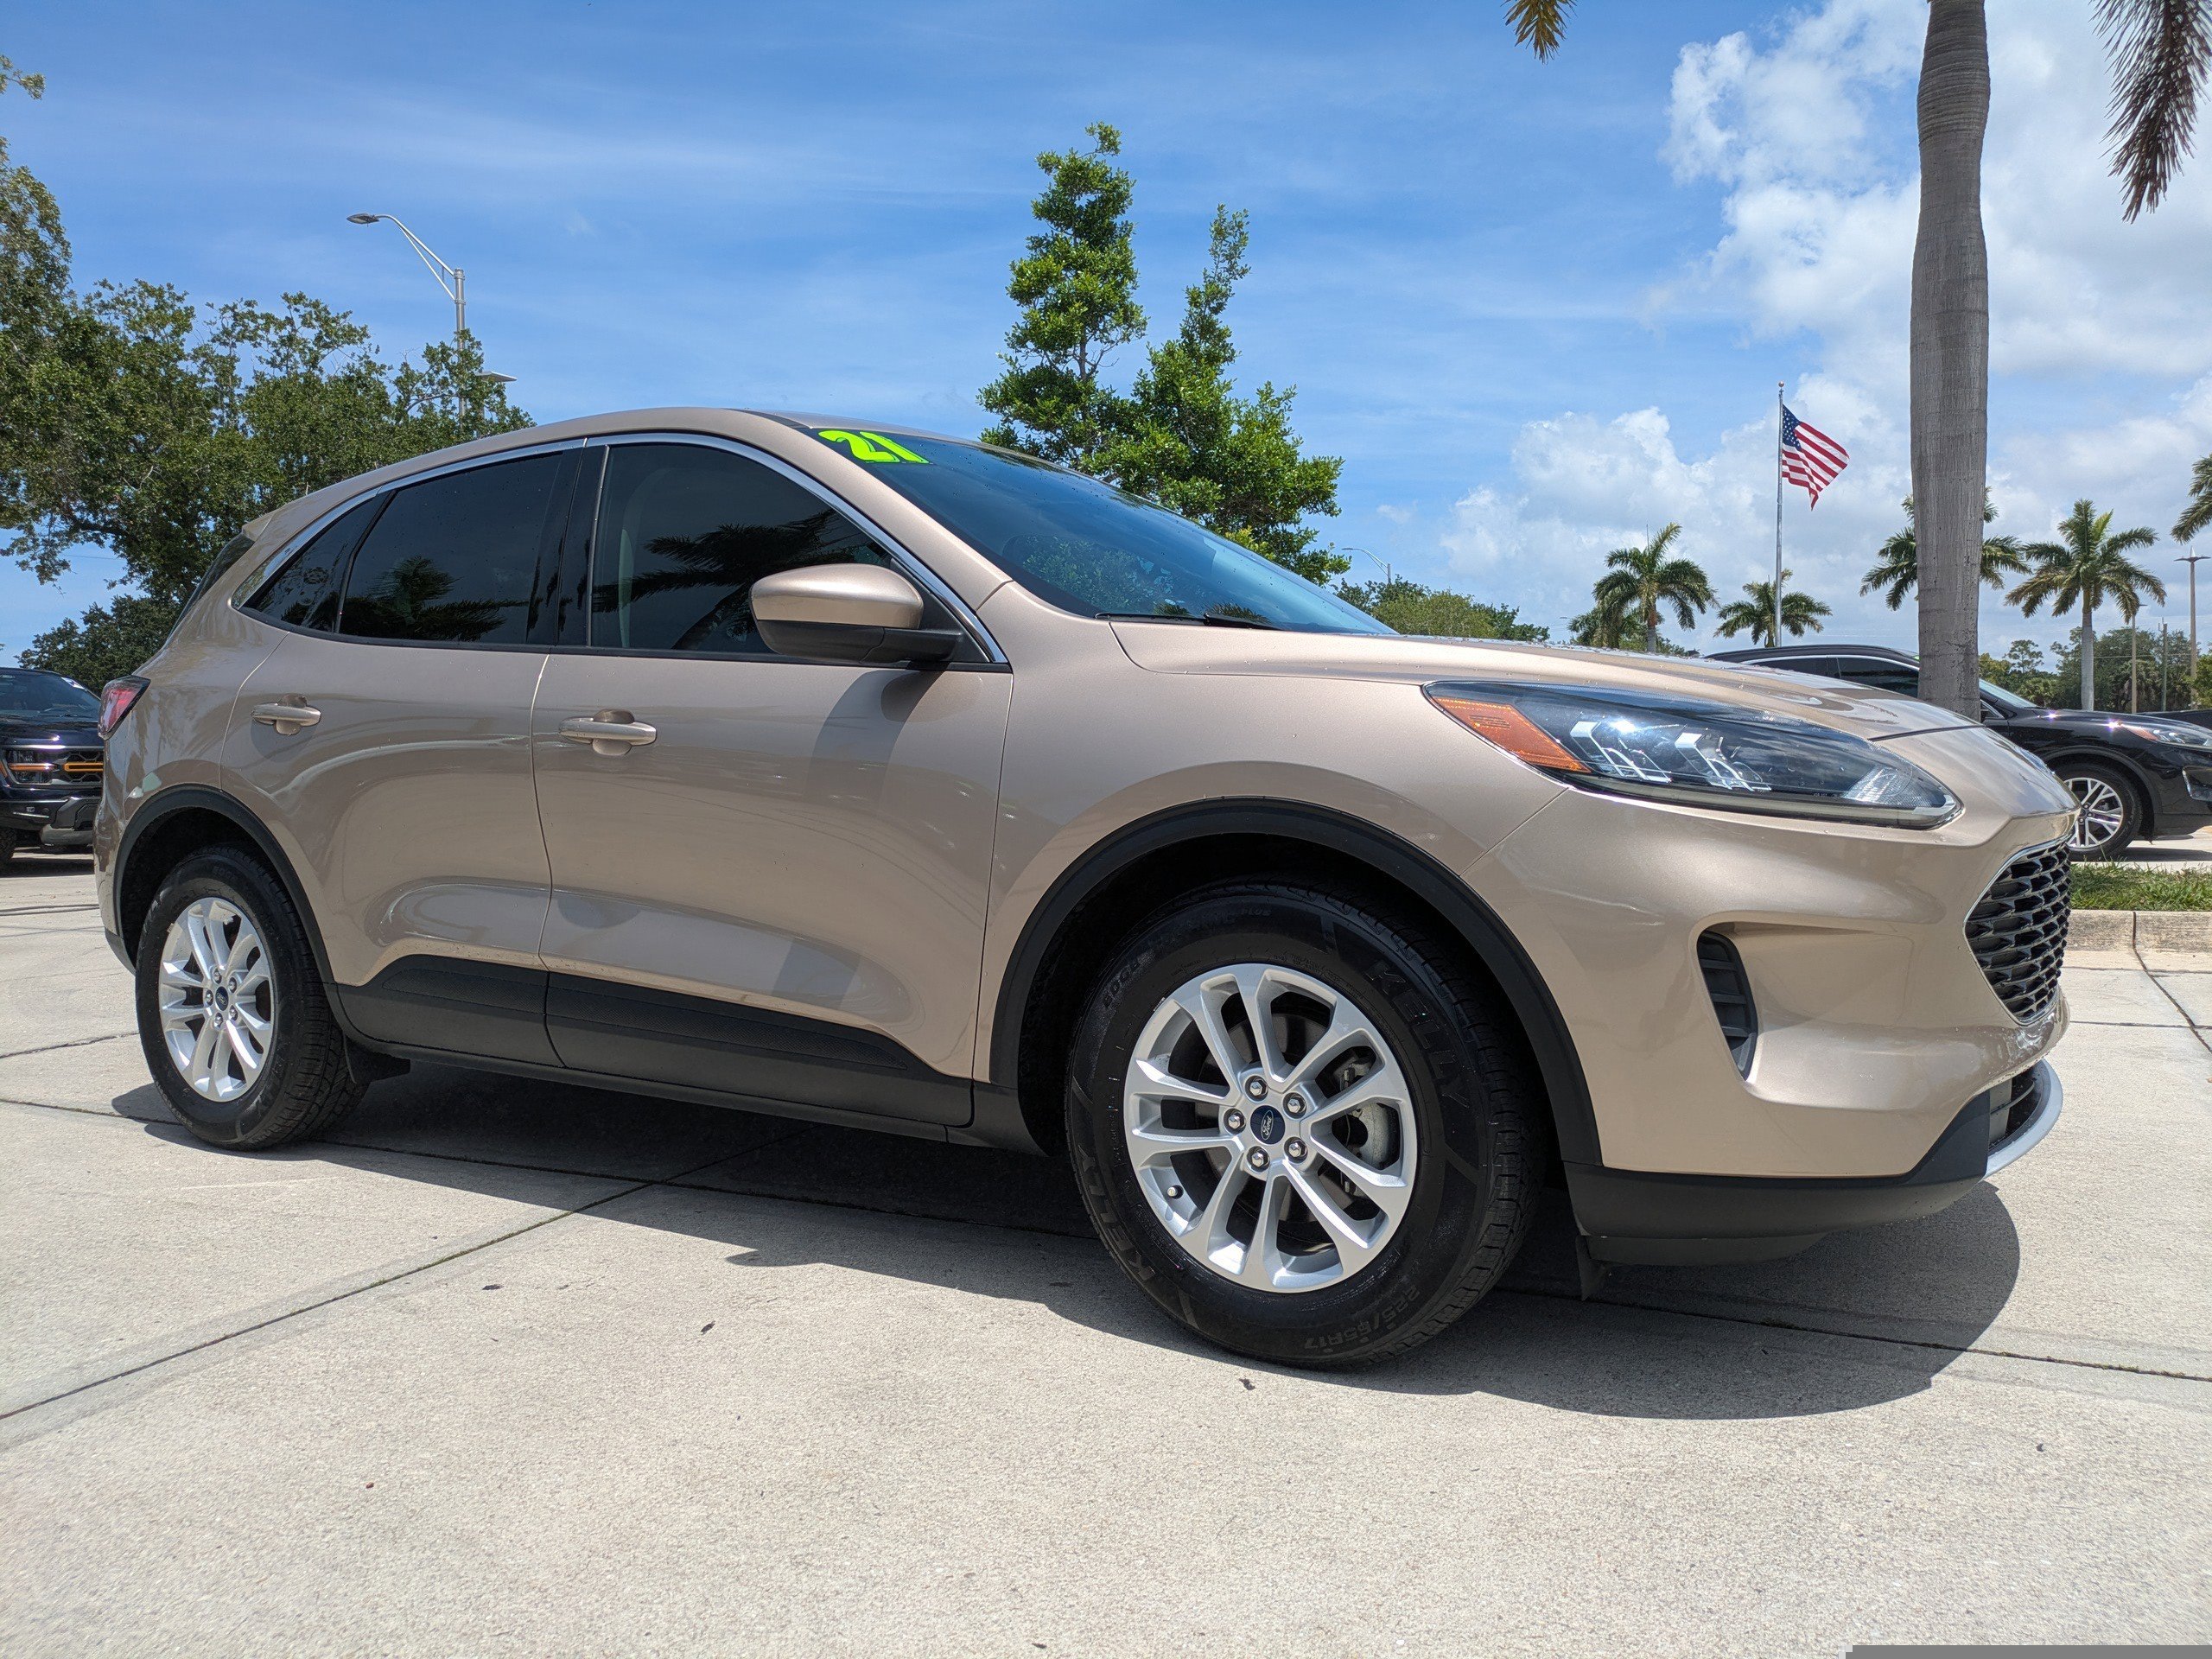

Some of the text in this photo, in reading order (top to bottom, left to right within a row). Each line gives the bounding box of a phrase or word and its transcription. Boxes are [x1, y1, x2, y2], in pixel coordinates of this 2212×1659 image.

[818, 430, 930, 463] 21
[1363, 961, 1470, 1109] KELLY
[1262, 1113, 1273, 1137] Ford
[1077, 1145, 1156, 1281] KELLY
[1304, 1285, 1420, 1349] 225/65R17
